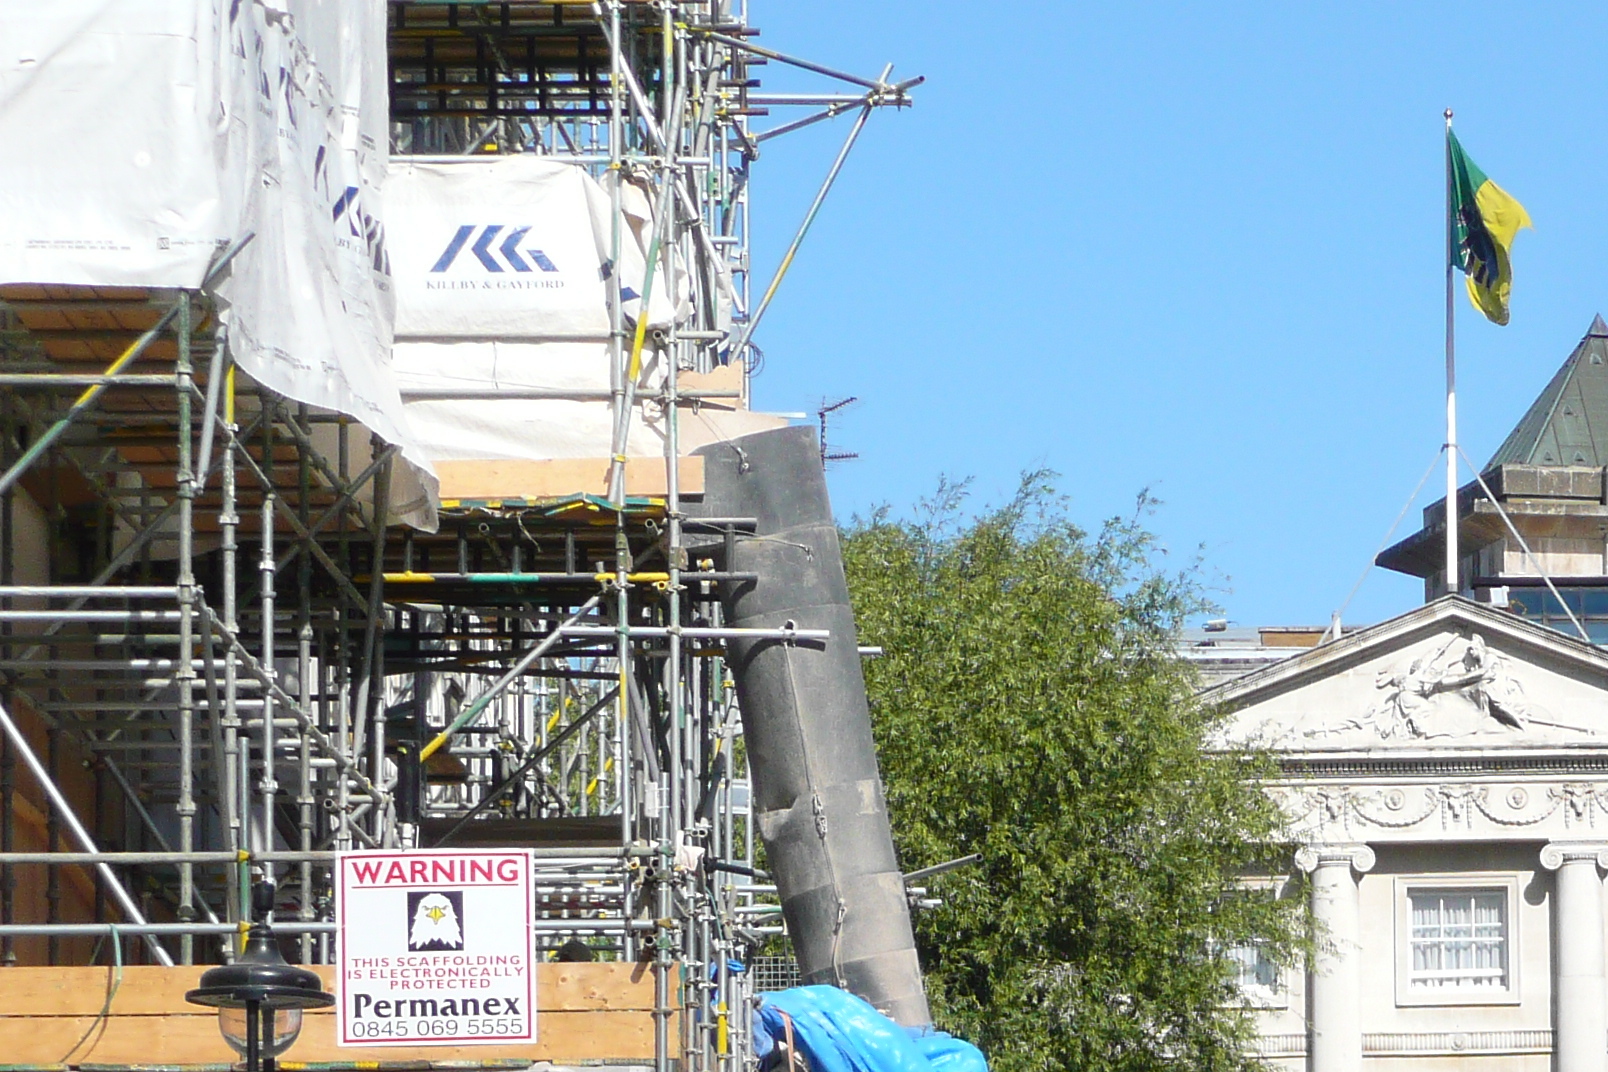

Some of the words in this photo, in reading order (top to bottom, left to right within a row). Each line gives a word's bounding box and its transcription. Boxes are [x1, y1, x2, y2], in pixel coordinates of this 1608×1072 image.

[426, 280, 478, 290] KILLBY
[482, 280, 492, 290] &
[497, 280, 565, 289] GAYFORD
[351, 859, 519, 885] WARNING
[351, 957, 390, 968] THIS
[397, 955, 521, 967] SCAFFOLDING
[348, 969, 362, 980] IS
[369, 966, 524, 979] ELECTRONICALLY
[390, 979, 491, 990] PROTECTED
[353, 993, 521, 1019] Permanex
[352, 1020, 408, 1038] 0845
[416, 1019, 459, 1036] 069
[467, 1018, 523, 1035] 5555
